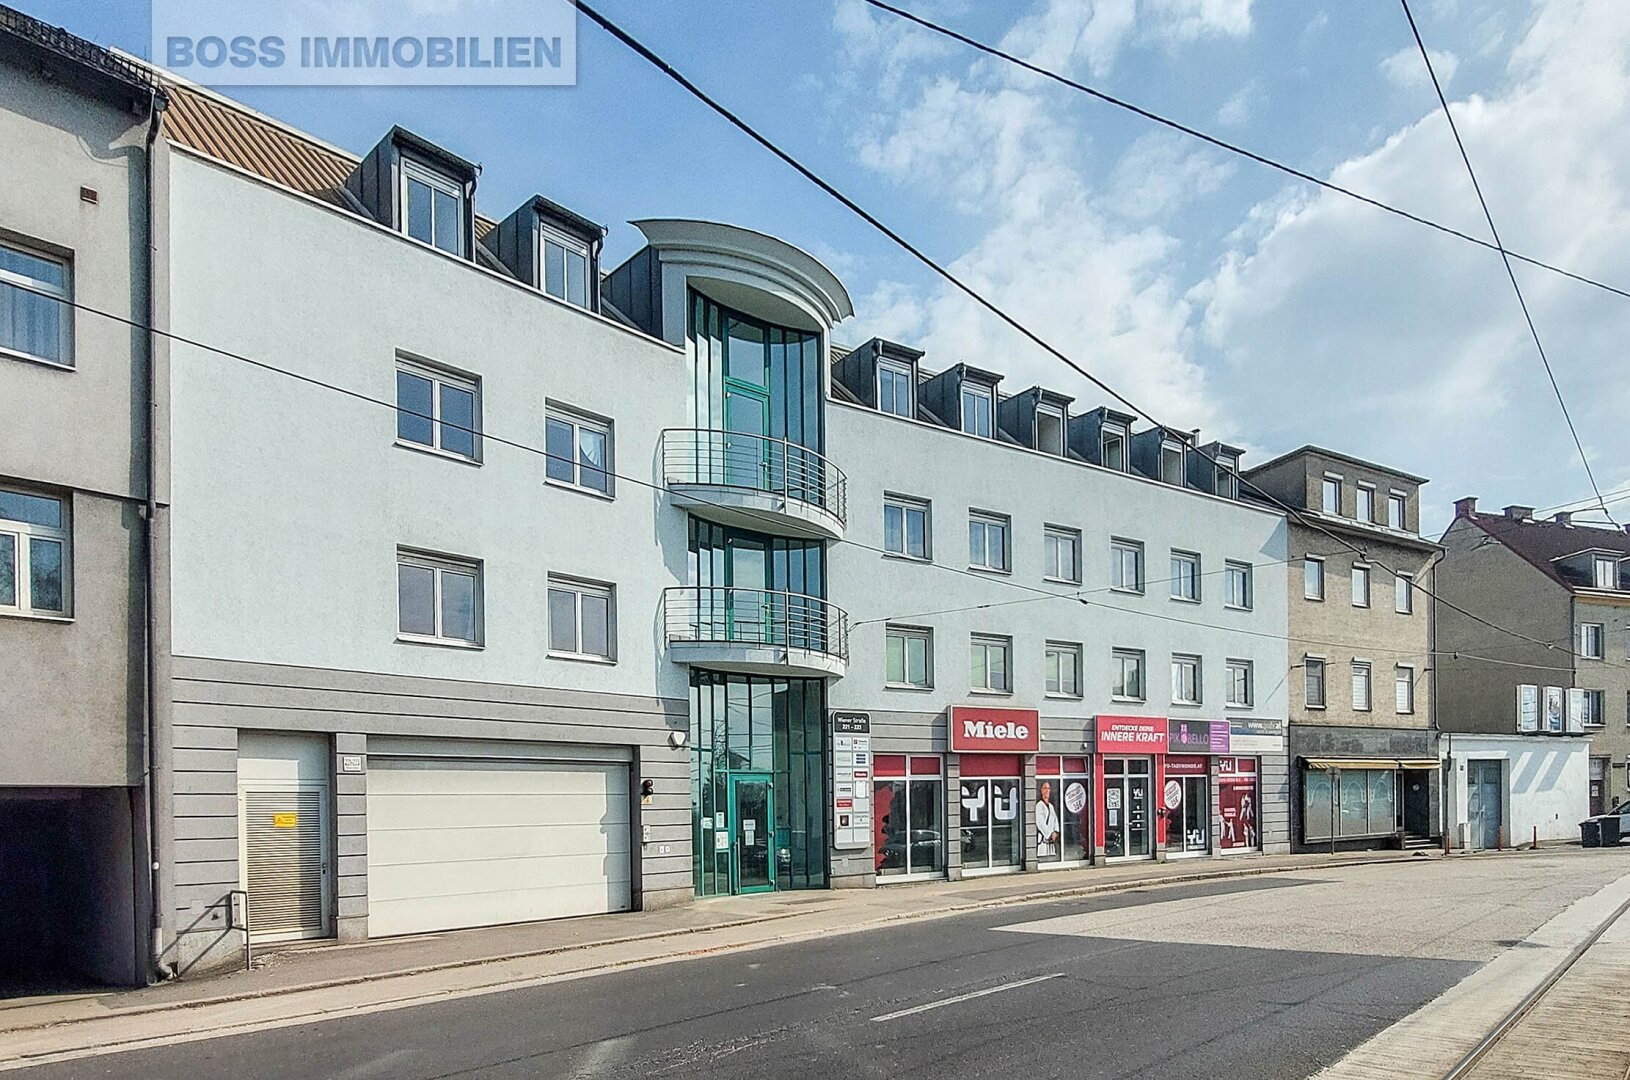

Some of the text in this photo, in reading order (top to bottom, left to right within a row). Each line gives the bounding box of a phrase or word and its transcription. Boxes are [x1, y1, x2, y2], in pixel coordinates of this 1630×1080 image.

[963, 720, 1029, 740] Miele
[1111, 724, 1138, 732] ENTDECKE
[1101, 731, 1165, 743] INNERE KRAFT
